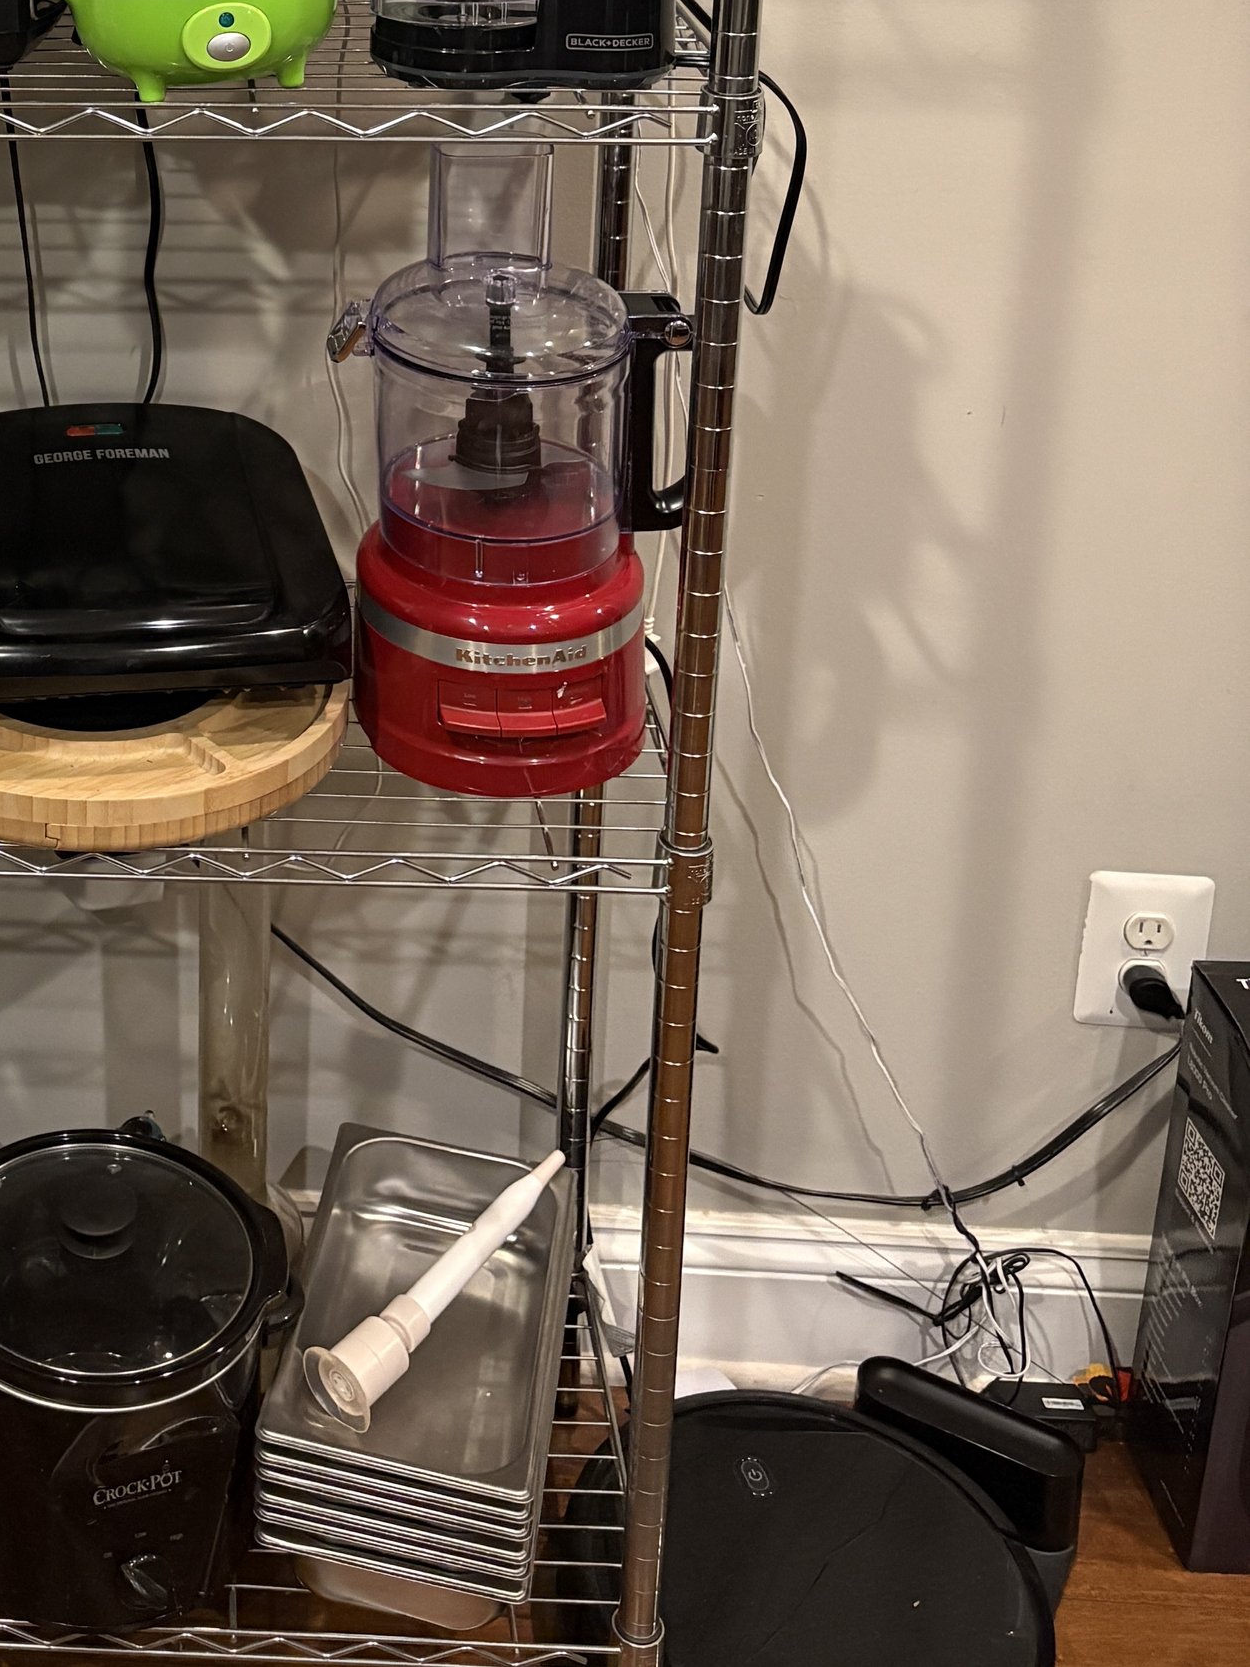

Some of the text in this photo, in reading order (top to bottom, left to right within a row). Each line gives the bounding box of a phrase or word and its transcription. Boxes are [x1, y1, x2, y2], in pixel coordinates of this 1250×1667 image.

[570, 37, 651, 47] BLACK+DECKER
[33, 448, 171, 465] GEORGE FOREMAN
[454, 645, 588, 667] KitchenAid
